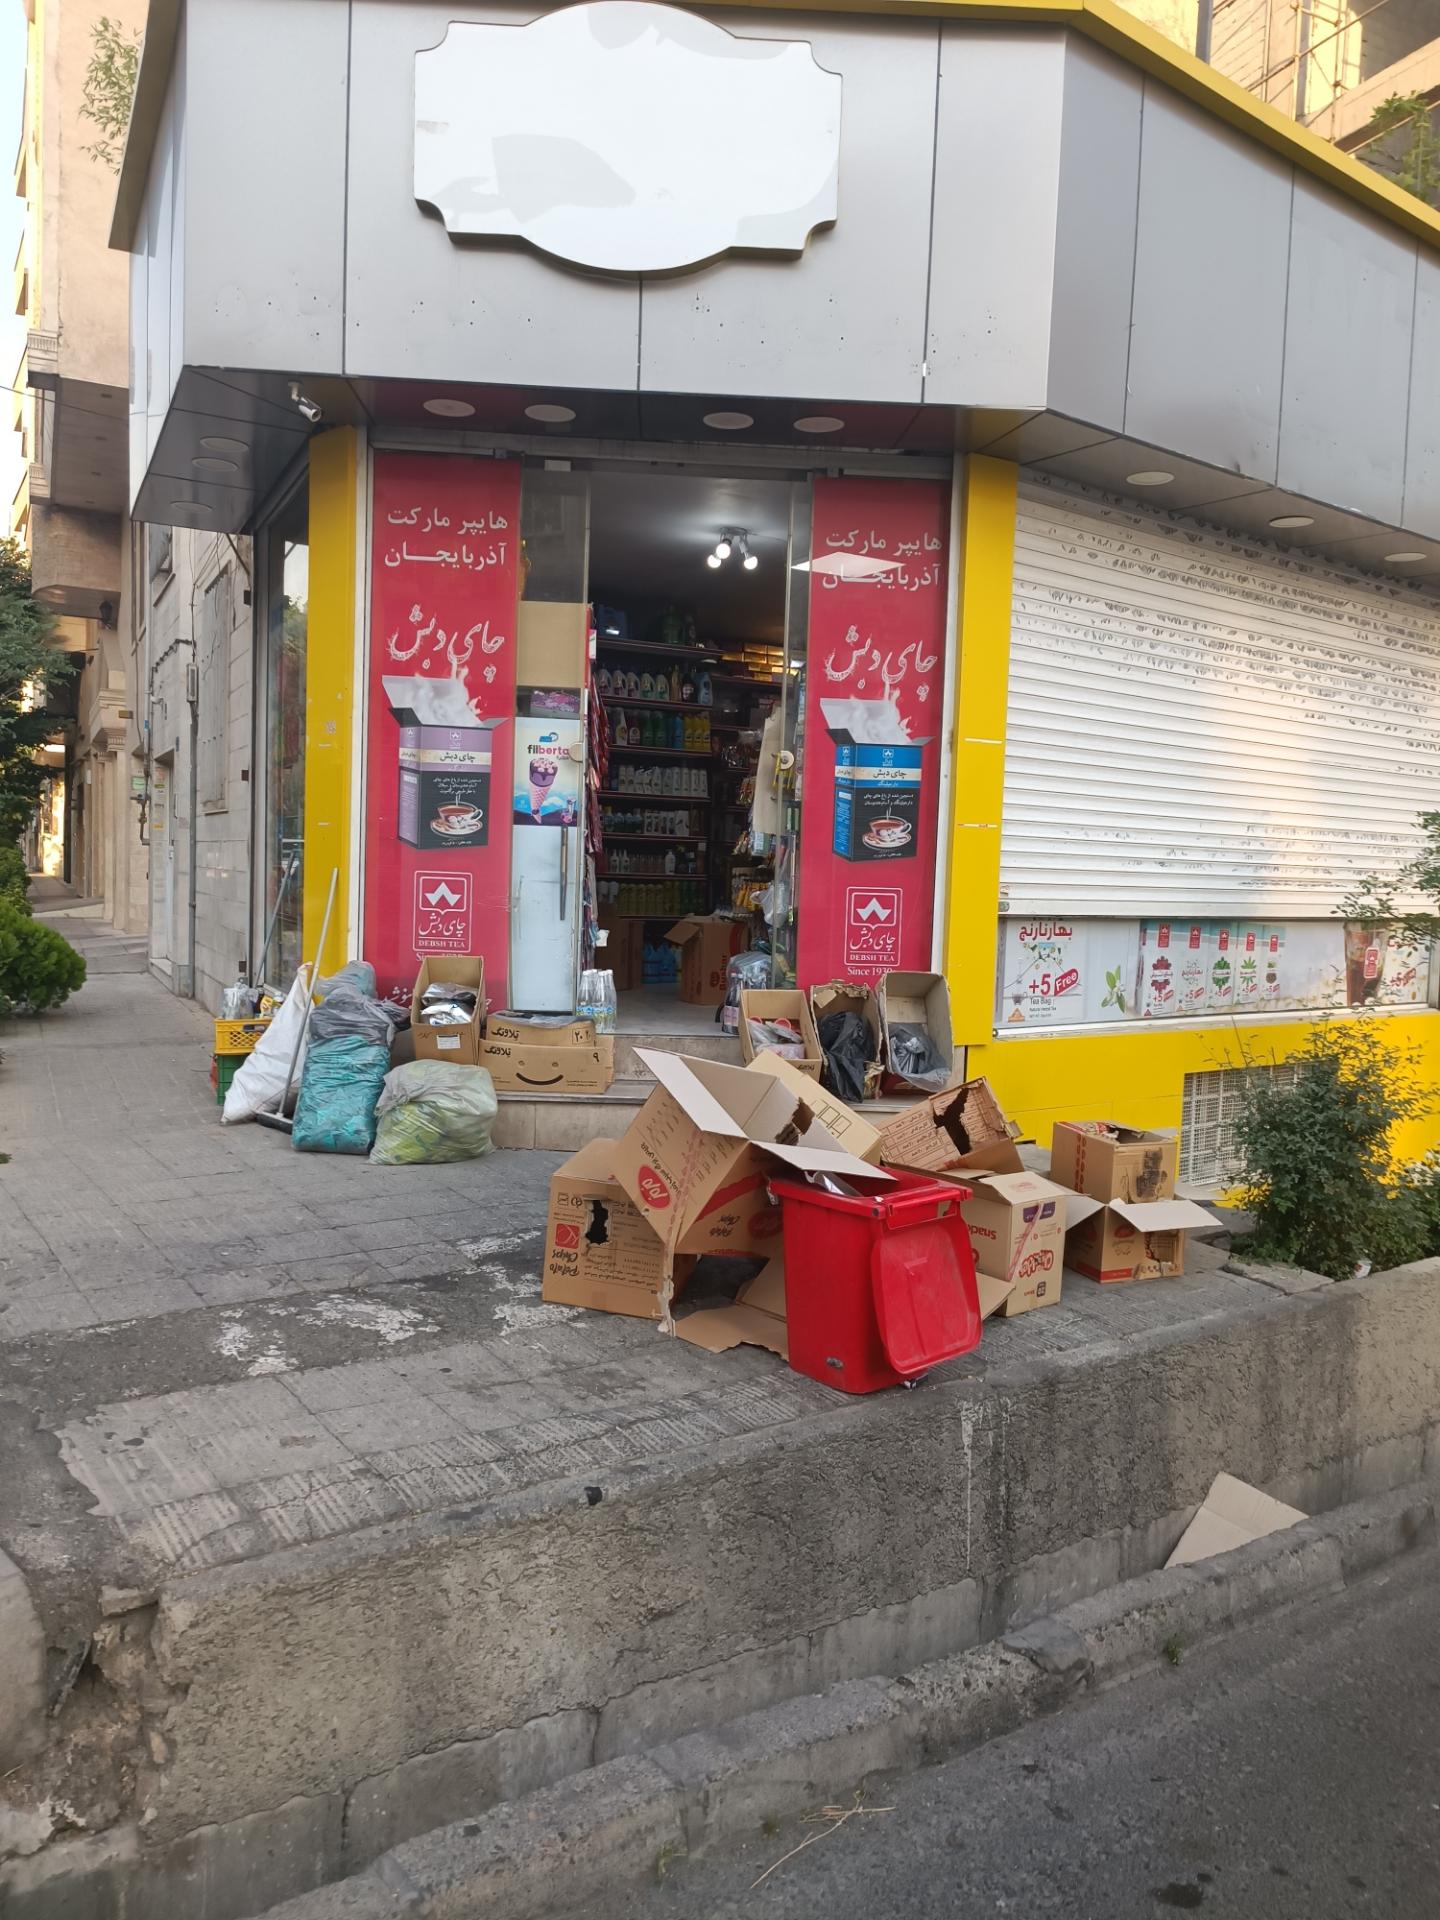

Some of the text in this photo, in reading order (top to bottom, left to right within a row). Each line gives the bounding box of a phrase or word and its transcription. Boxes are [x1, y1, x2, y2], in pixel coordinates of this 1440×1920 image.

[387, 507, 508, 535] هایپر مارکت
[825, 530, 942, 556] هایپر مارکت
[384, 541, 506, 571] آذربایجان
[822, 563, 941, 591] آذربایجان
[387, 603, 505, 683] چای دبش
[824, 624, 938, 702] چای دبش
[439, 752, 476, 763] چای دبش
[873, 769, 907, 779] چای دبش
[418, 912, 466, 937] چای دبش
[418, 940, 446, 948] DEBSH
[849, 927, 896, 951] چای دبش
[847, 966, 870, 976] Since
[1028, 972, 1077, 996] +5 Free
[549, 1263, 579, 1276] Potato
